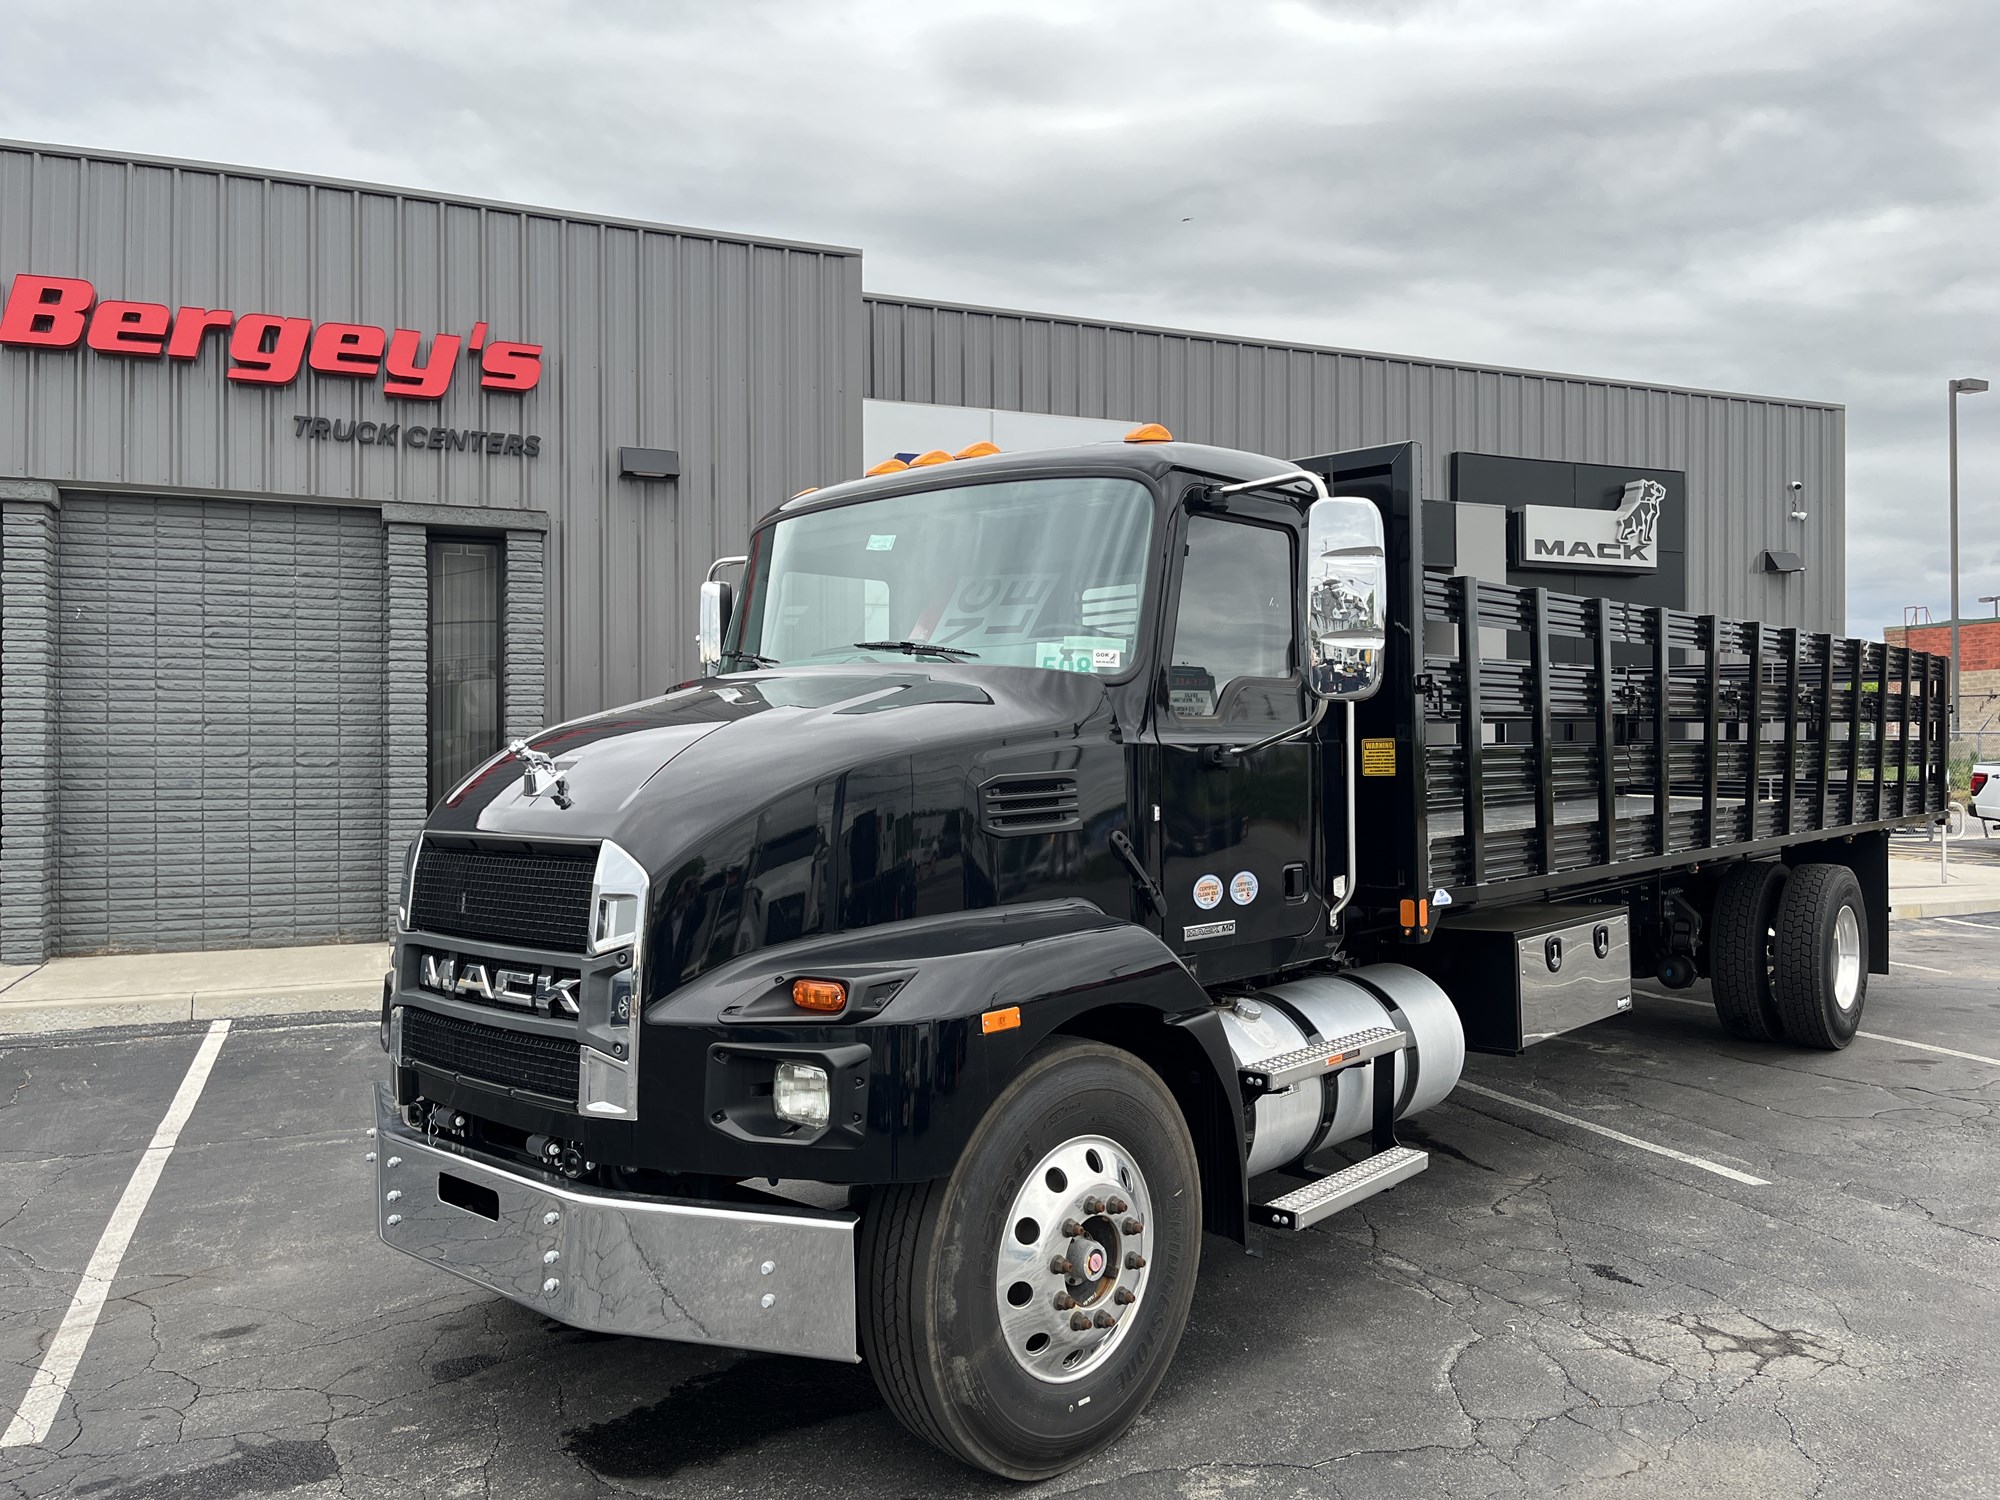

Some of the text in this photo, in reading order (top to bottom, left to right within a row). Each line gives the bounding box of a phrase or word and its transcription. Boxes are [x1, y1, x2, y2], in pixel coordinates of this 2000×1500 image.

[0, 273, 543, 400] Bergey's
[294, 415, 541, 457] TRUCK CENTERS
[1534, 539, 1650, 562] MACK
[1365, 741, 1394, 750] WARNING
[1186, 924, 1235, 938] MACK MD
[420, 954, 581, 1014] MACK
